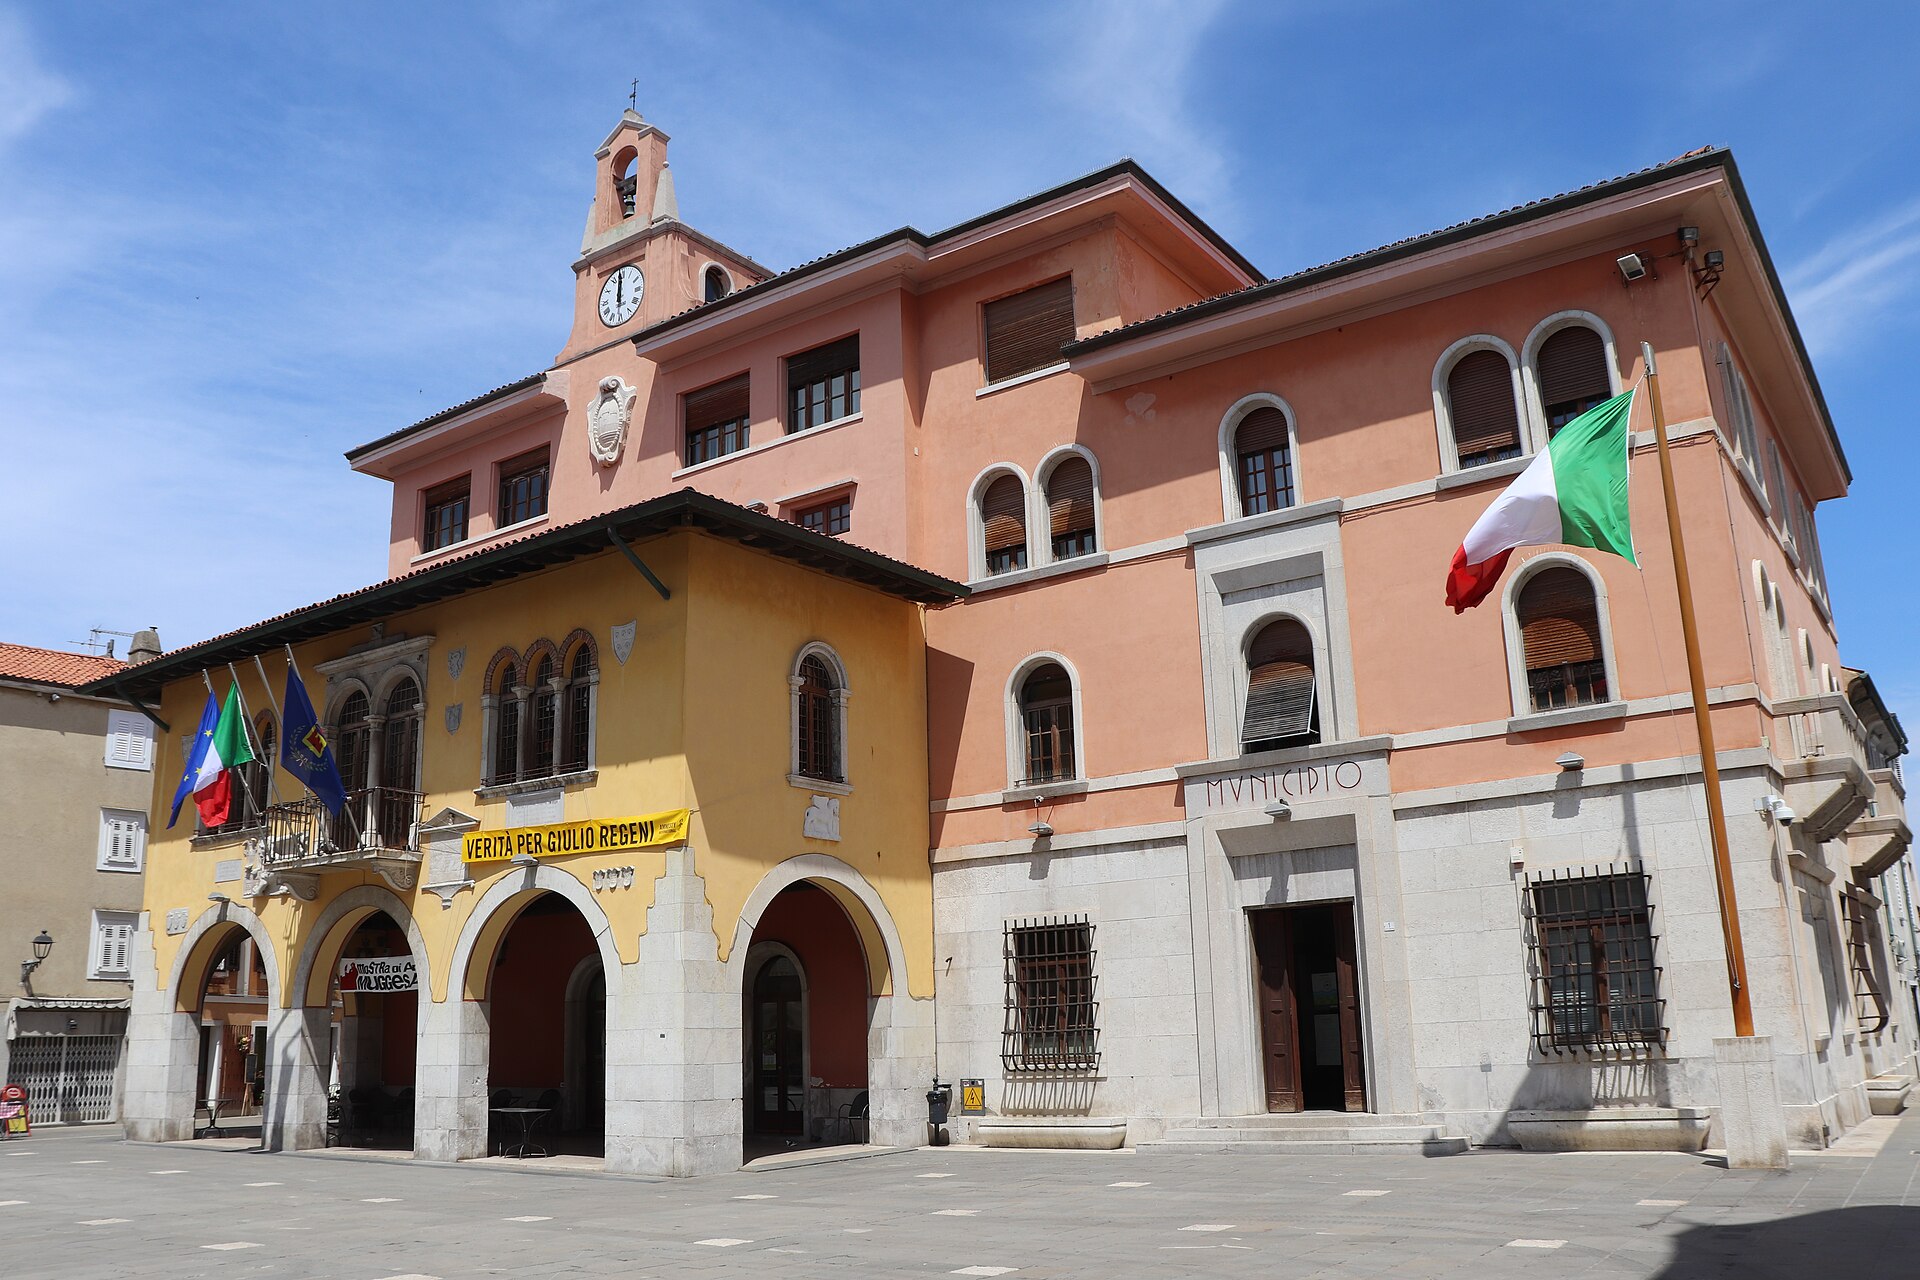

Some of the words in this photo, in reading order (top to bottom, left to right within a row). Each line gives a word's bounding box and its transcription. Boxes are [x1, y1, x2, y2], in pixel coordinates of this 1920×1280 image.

[467, 831, 513, 859] VERITÀ
[517, 833, 543, 854] PER
[548, 826, 595, 852] GIULIO
[600, 820, 655, 847] REGENI
